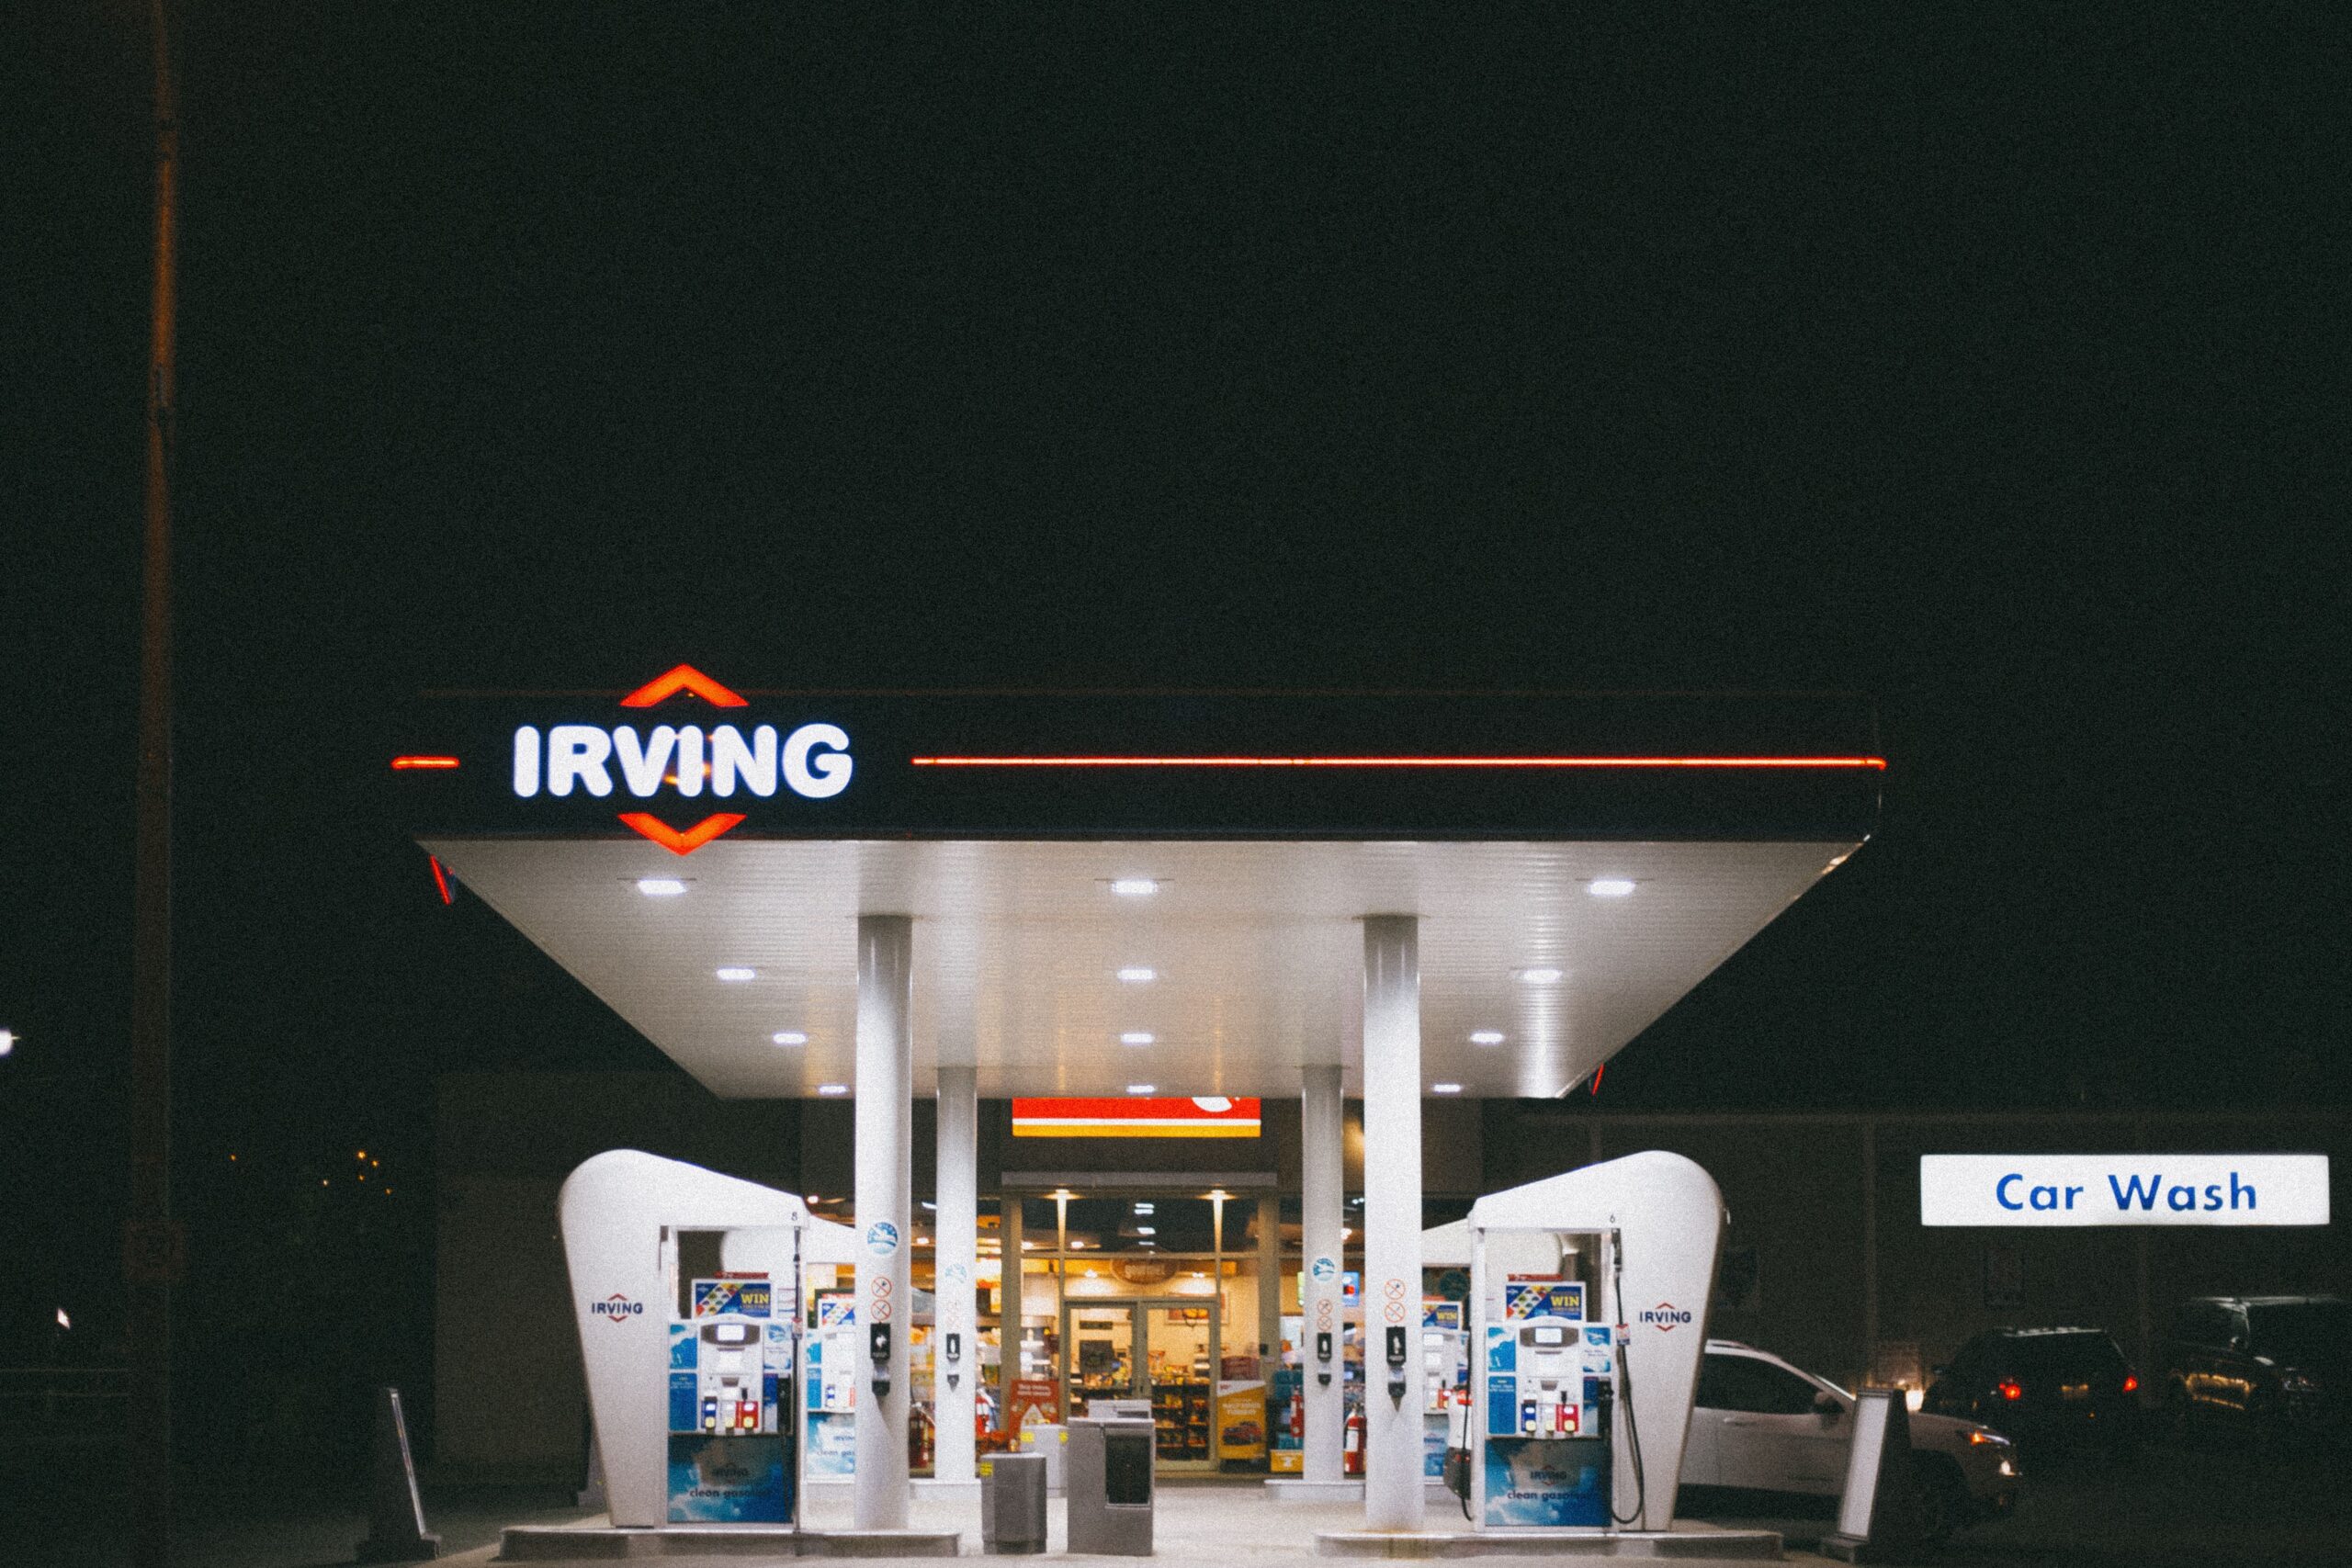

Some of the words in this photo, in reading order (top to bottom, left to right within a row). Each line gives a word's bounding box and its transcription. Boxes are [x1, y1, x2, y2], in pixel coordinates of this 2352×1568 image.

[513, 723, 854, 798] IRVING
[1996, 1173, 2085, 1212] Car
[2107, 1171, 2257, 1212] Wash
[741, 1292, 770, 1304] WIN
[1550, 1295, 1580, 1307] WIN
[591, 1302, 644, 1314] IRVING
[1639, 1311, 1692, 1324] IRVING
[689, 1487, 720, 1498] clean
[1507, 1490, 1538, 1500] clean
